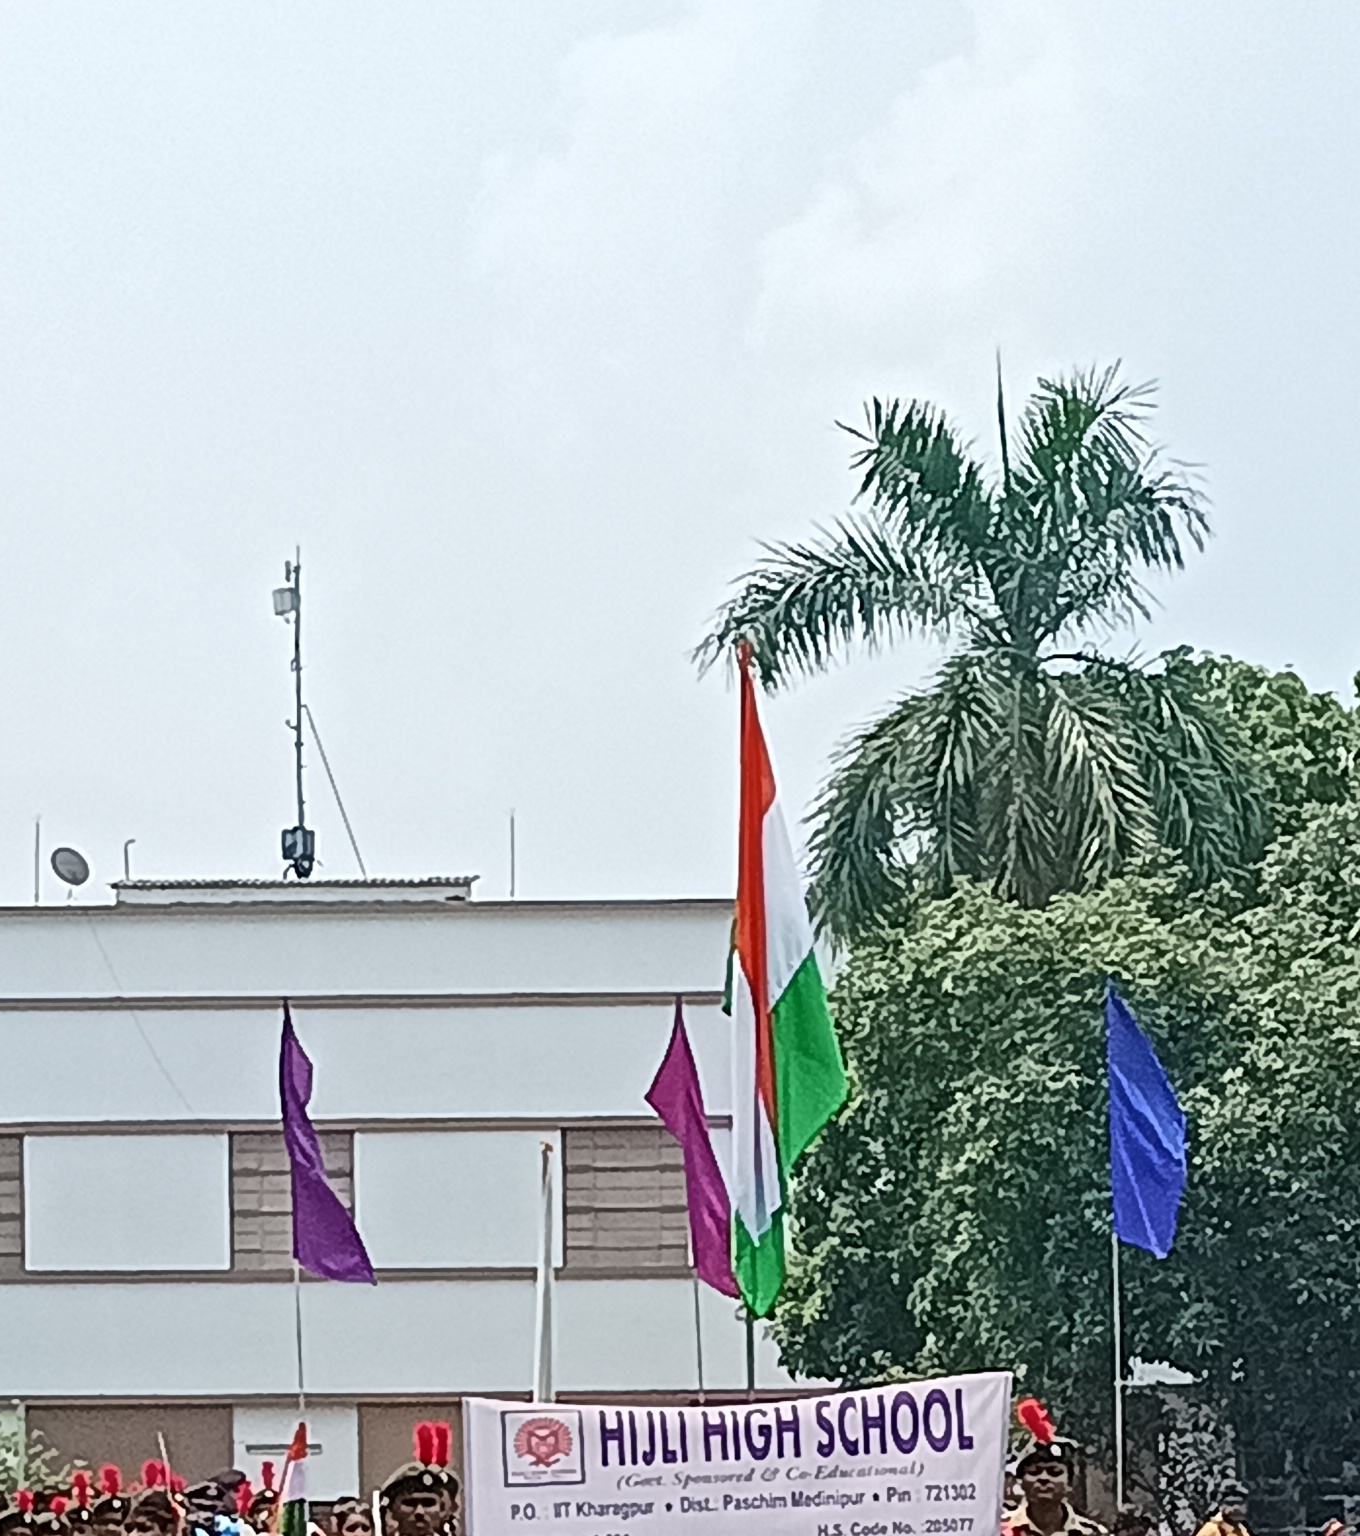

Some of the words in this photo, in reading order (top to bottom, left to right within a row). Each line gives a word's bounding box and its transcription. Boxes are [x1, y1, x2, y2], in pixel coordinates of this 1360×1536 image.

[598, 1409, 688, 1467] HIJLI
[701, 1404, 802, 1463] HIGH
[814, 1387, 975, 1458] SCHOOL
[671, 1466, 756, 1490] Sponsored
[760, 1465, 779, 1482] &
[553, 1502, 571, 1519] IIT
[575, 1500, 655, 1521] Kharagpur
[723, 1490, 788, 1511] Paschim
[791, 1488, 866, 1509] Medinipur
[886, 1486, 912, 1503] Pin
[924, 1482, 976, 1501] 721302
[849, 1521, 888, 1536] Code
